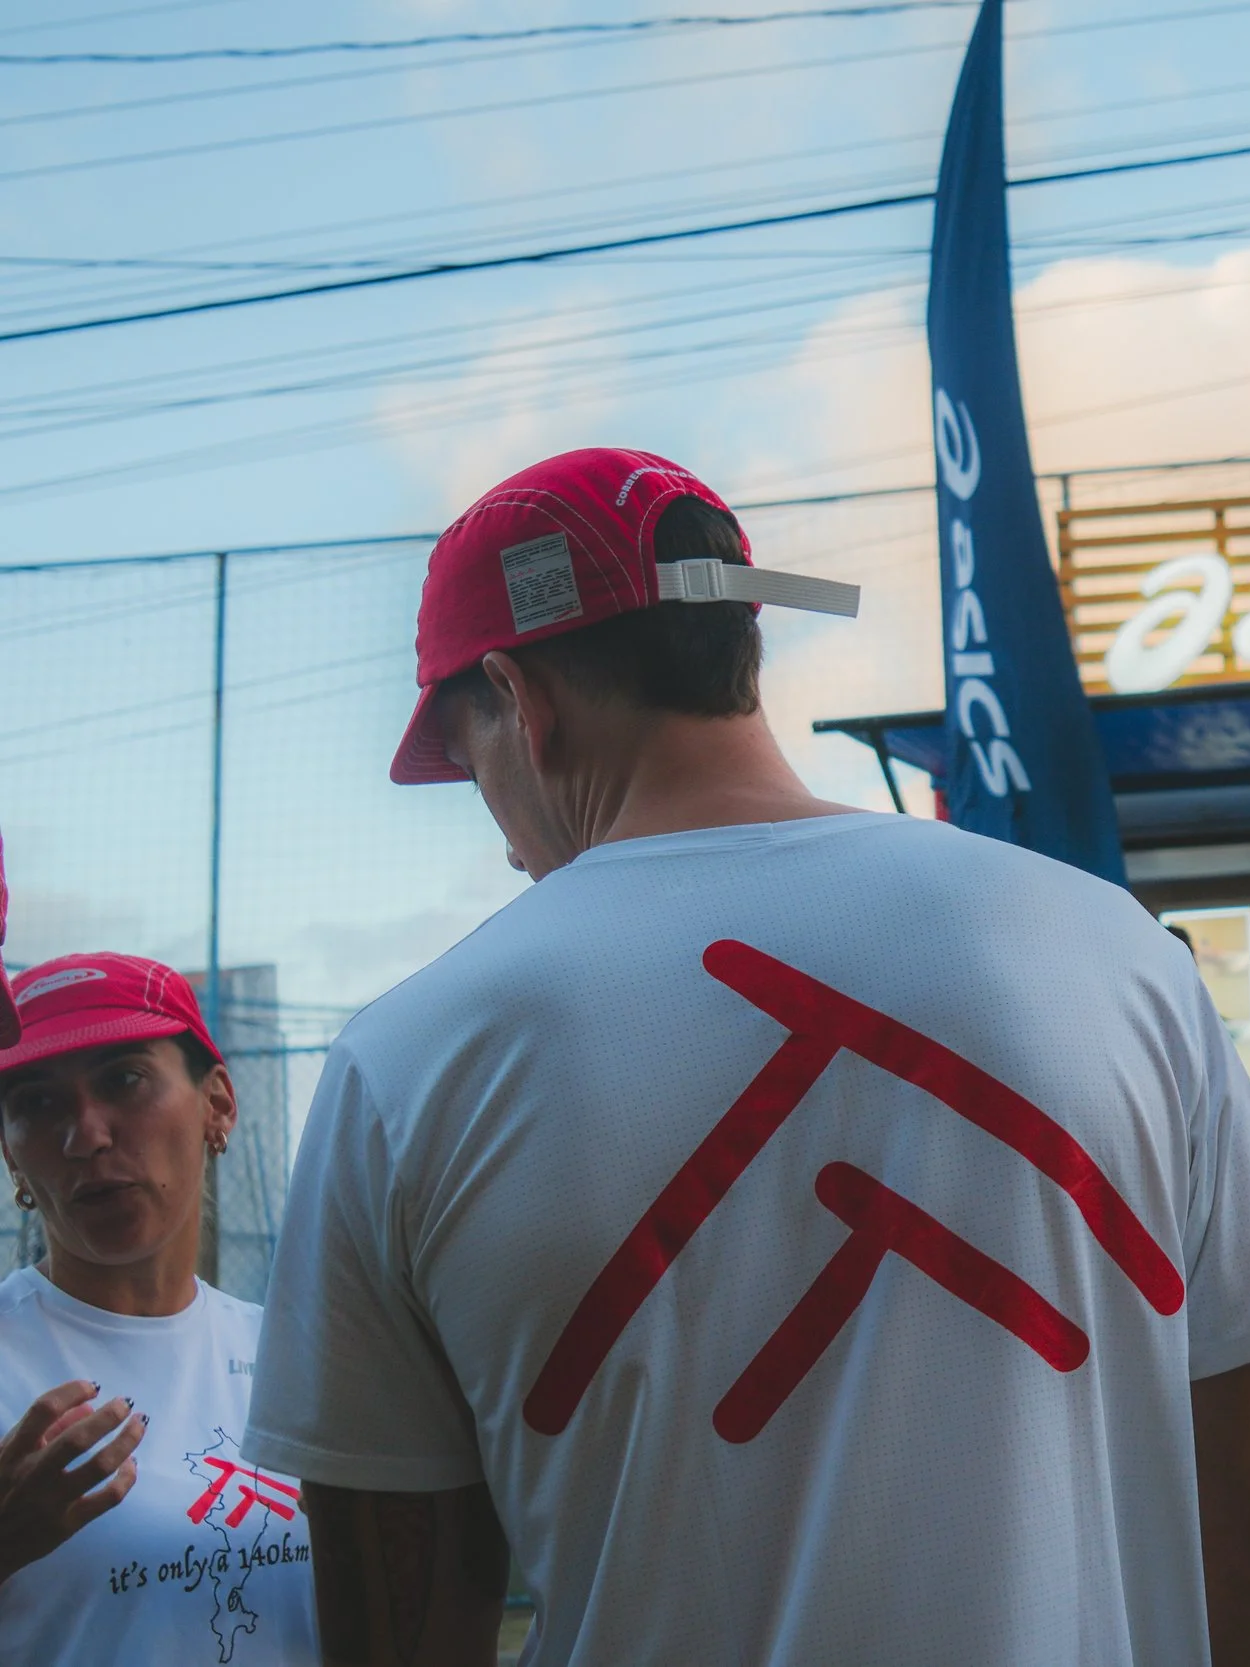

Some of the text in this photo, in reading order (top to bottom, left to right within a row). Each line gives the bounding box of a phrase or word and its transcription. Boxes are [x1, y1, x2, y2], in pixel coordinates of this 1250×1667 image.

[951, 519, 1032, 798] asics
[109, 1532, 309, 1594] it's only a 140km
